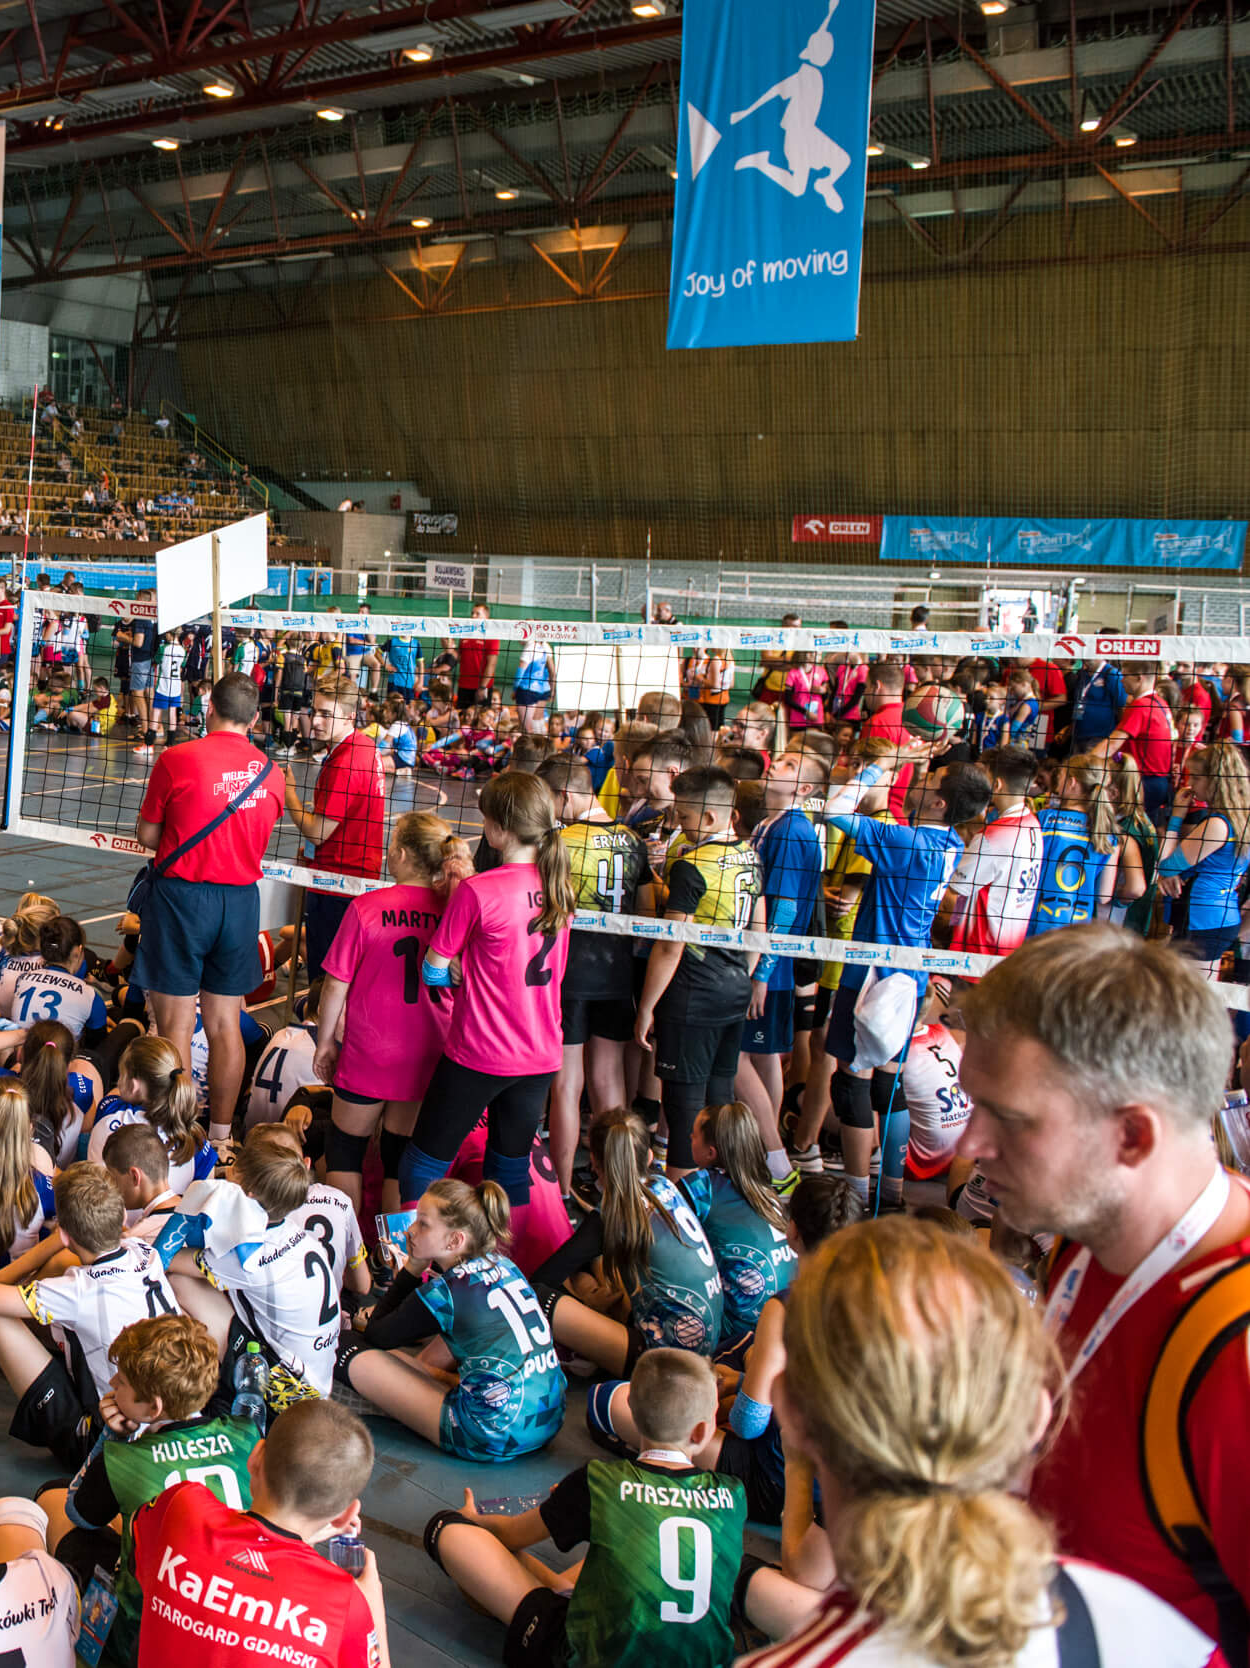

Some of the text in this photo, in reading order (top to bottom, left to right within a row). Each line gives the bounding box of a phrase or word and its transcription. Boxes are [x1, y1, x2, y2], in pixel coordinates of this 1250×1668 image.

[682, 249, 848, 298] Joy of moving
[830, 522, 869, 534] ORLEN
[535, 624, 578, 633] POLSKA
[1099, 640, 1159, 655] ORLEN
[113, 839, 146, 854] ORLEN
[593, 833, 629, 850] ERYK
[597, 853, 626, 914] 4
[1054, 845, 1090, 892] 6
[382, 909, 442, 929] MARTY
[18, 986, 64, 1023] 13
[255, 1046, 289, 1105] 4
[673, 1206, 715, 1268] 9
[304, 1250, 339, 1327] 2
[487, 1278, 552, 1355] 15
[151, 1434, 234, 1464] KULESZA
[620, 1480, 735, 1510] PTASZYŃSKI
[658, 1516, 713, 1624] 9
[156, 1544, 329, 1648] KaEmKa
[151, 1594, 319, 1668] STAROGARD GDAŃSKI
